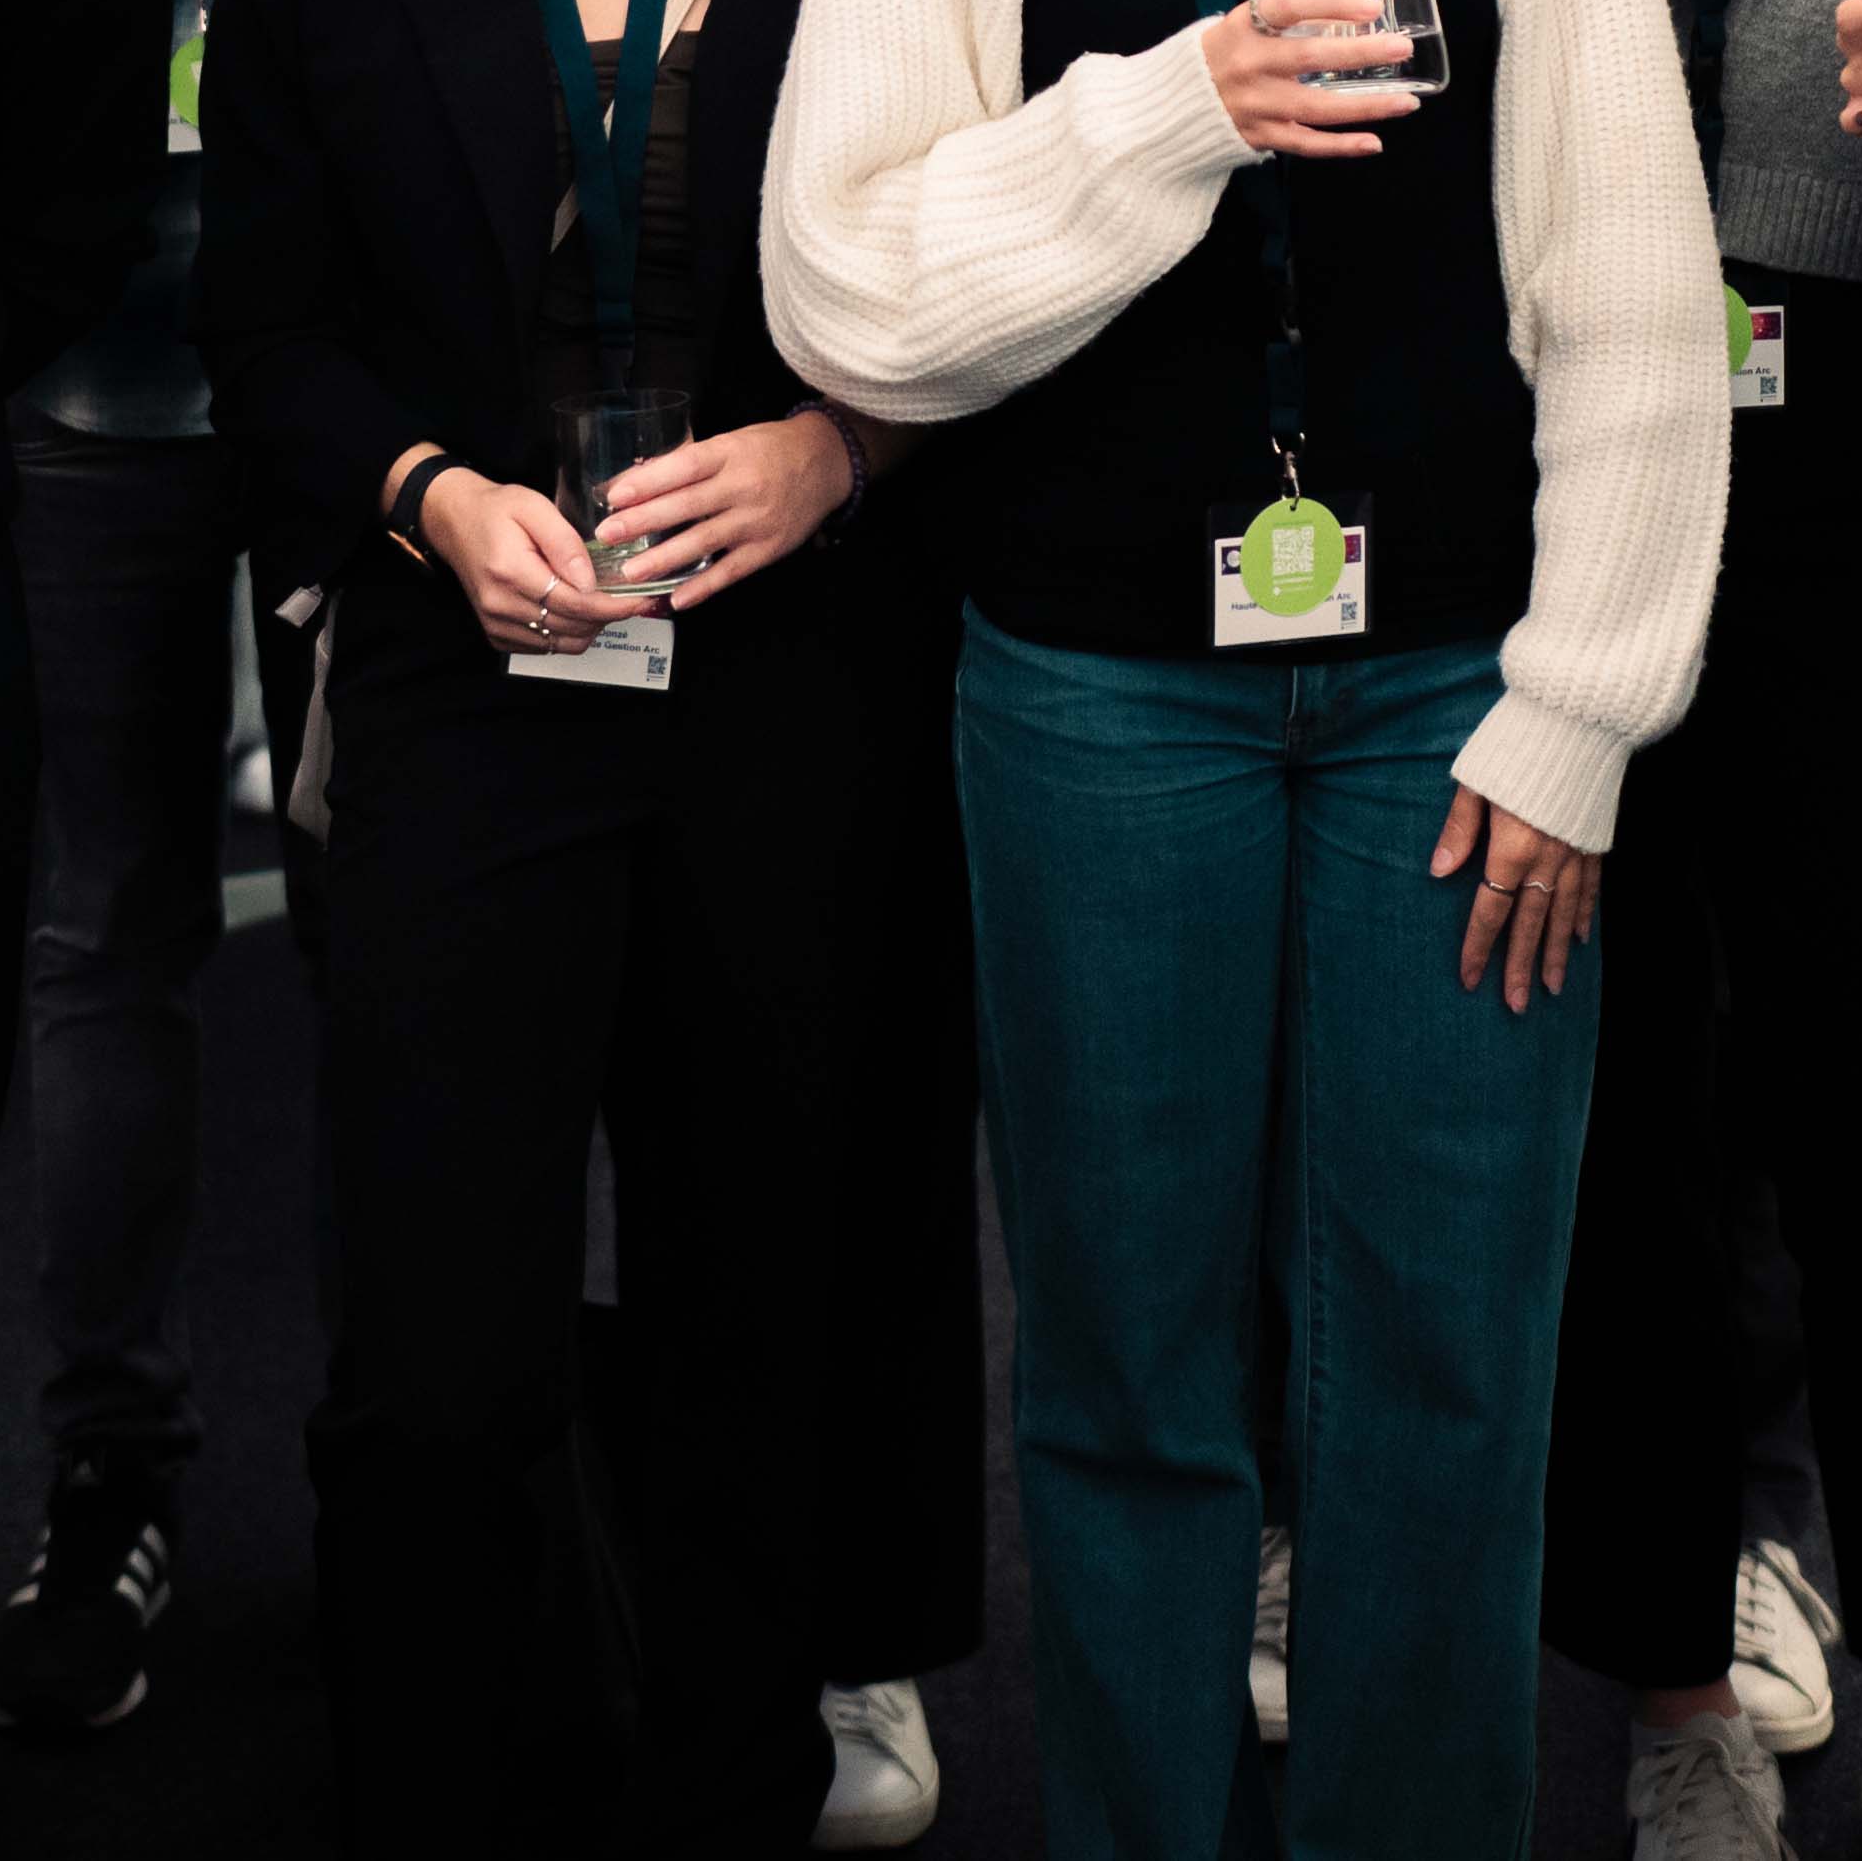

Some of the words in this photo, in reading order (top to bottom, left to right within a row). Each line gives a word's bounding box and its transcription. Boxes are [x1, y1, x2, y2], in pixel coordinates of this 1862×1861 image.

[1756, 366, 1771, 374] Arc
[1231, 601, 1257, 611] Haute
[1338, 593, 1352, 601] Arc
[604, 640, 642, 653] Gestion
[643, 645, 660, 655] Arc
